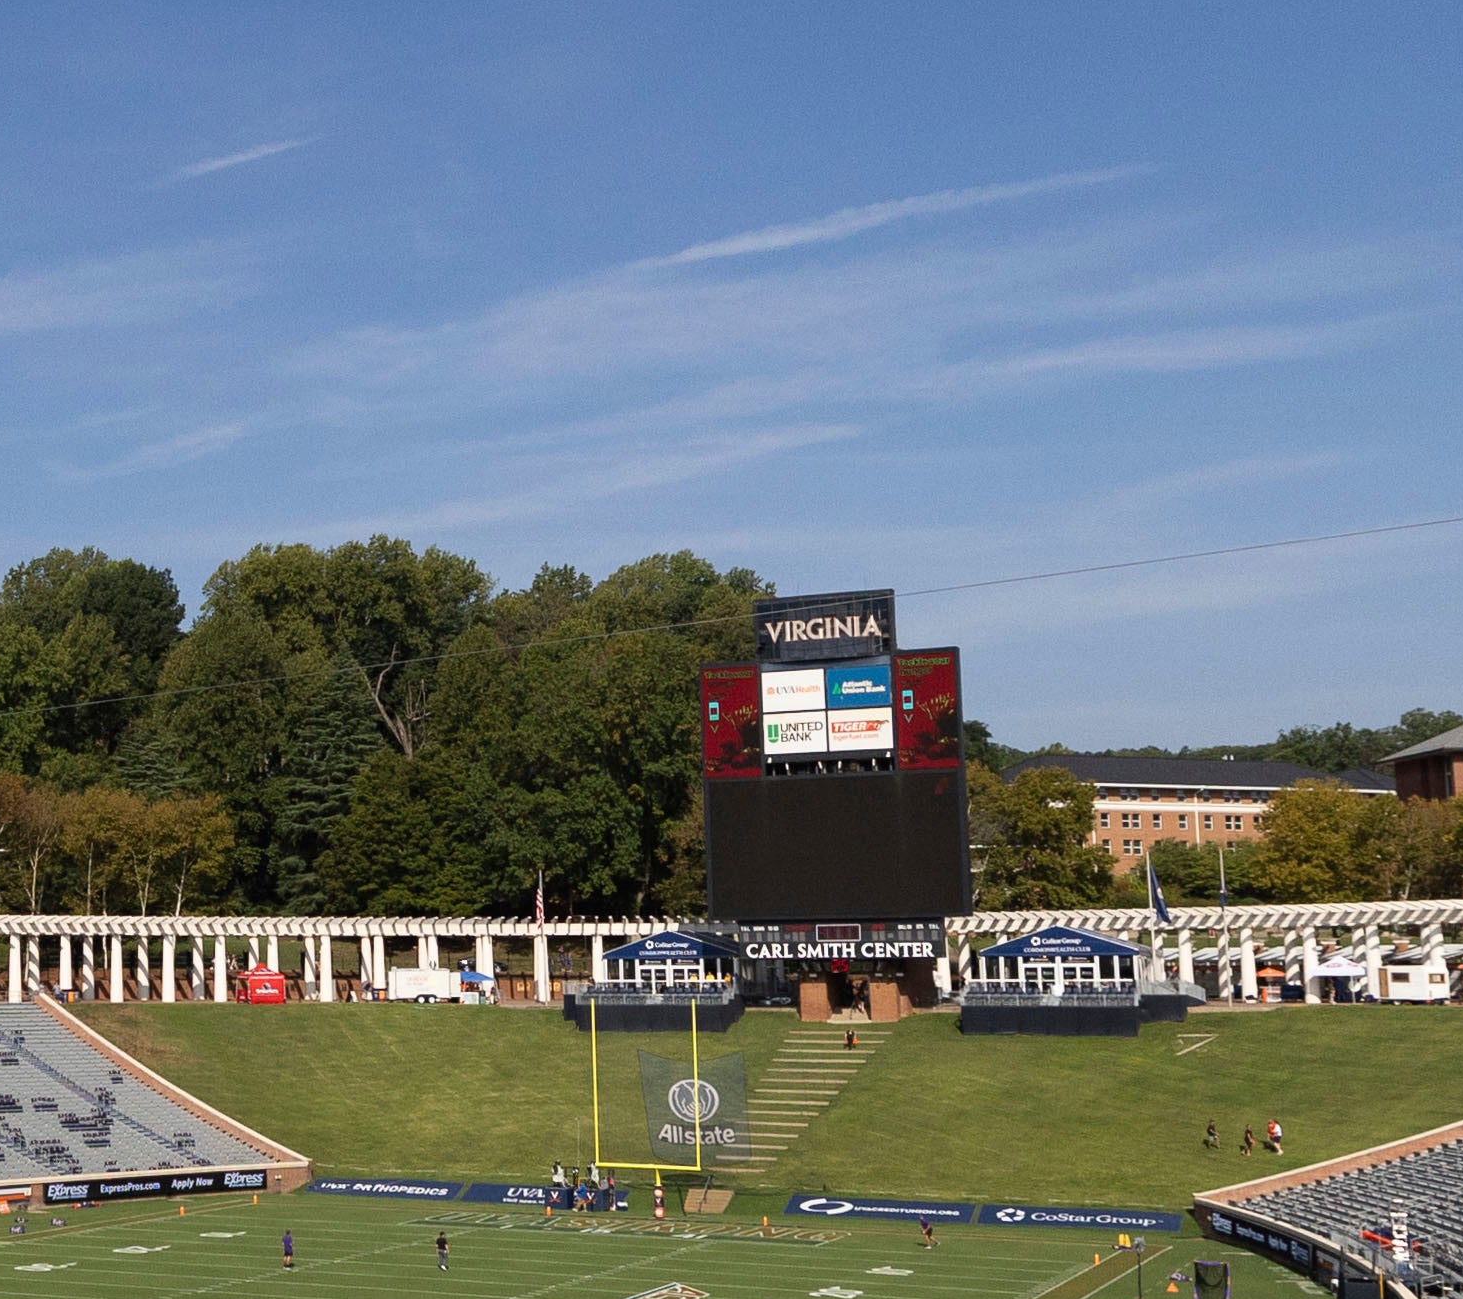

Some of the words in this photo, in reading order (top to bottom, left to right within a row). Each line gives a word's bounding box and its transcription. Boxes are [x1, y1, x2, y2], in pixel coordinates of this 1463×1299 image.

[765, 614, 882, 644] VIRGINIA
[842, 679, 873, 688] Atlantic
[842, 686, 866, 694] Union
[866, 685, 886, 693] Bank
[776, 686, 795, 695] UVA
[795, 685, 820, 694] Health
[780, 722, 823, 733] UNITED
[833, 721, 867, 732] TIGER
[780, 731, 812, 743] BANK
[745, 943, 794, 959] CARL
[797, 942, 856, 958] SMITH
[860, 942, 935, 958] CENTER
[171, 1179, 193, 1190] Apply
[195, 1178, 214, 1188] Now
[223, 1173, 264, 1187] Express
[47, 1183, 89, 1200] Express
[100, 1182, 161, 1195] ExpressPros.com
[353, 1183, 449, 1197] ORTHOPEDICS
[507, 1187, 545, 1198] UVA
[1030, 1212, 1095, 1223] CoStar
[1096, 1214, 1157, 1227] Group
[555, 1217, 852, 1243] STRONG
